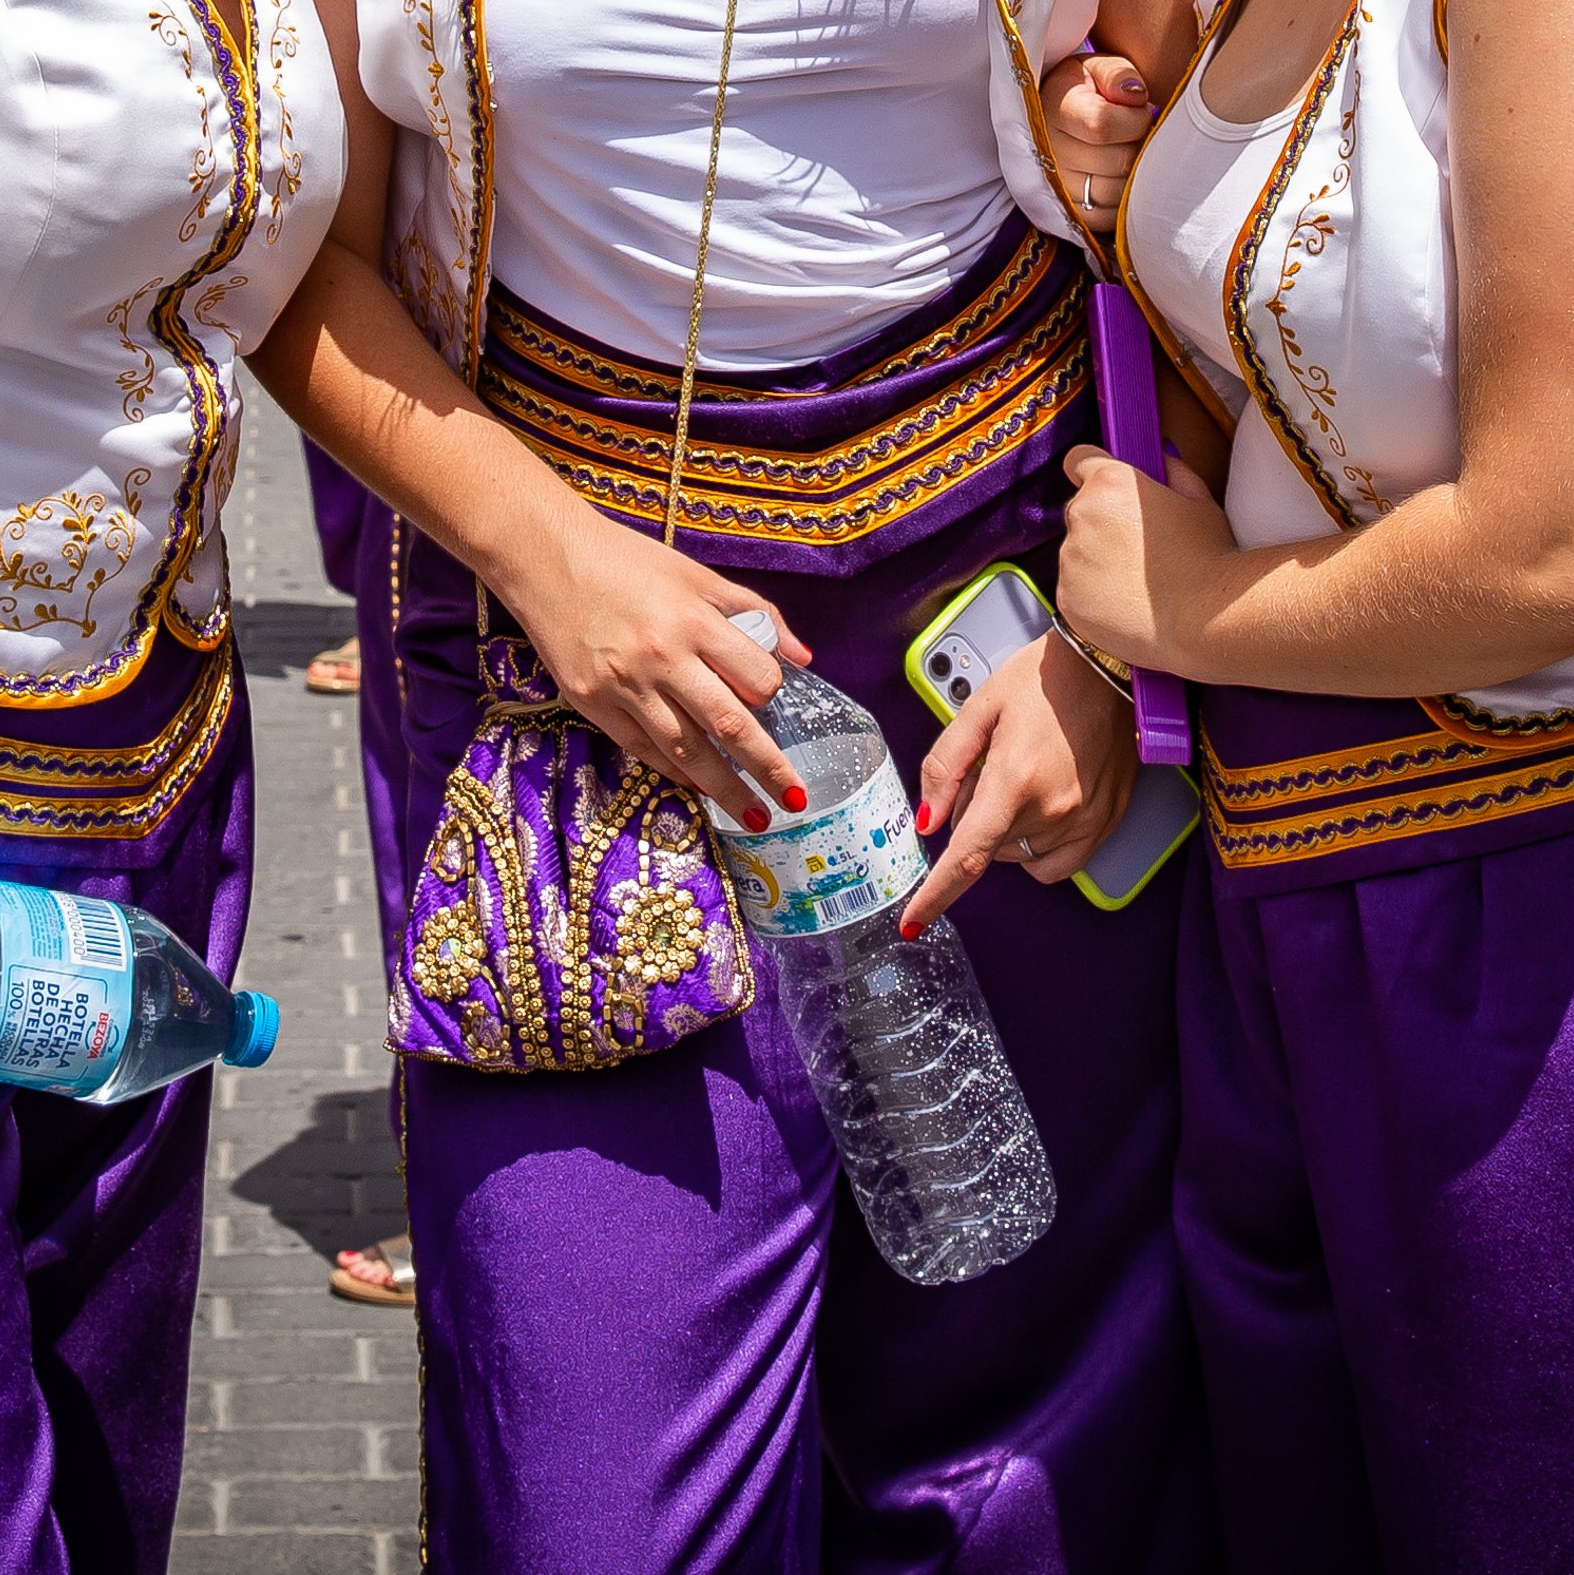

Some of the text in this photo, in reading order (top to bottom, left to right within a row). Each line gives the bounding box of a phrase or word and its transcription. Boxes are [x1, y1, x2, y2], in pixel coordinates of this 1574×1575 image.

[10, 979, 45, 1066] BOTELLAS
[26, 983, 60, 1068] DE OTRAS
[45, 999, 74, 1060] HECHA
[56, 993, 89, 1069] BOTELLA
[87, 1012, 110, 1061] BEZOYA
